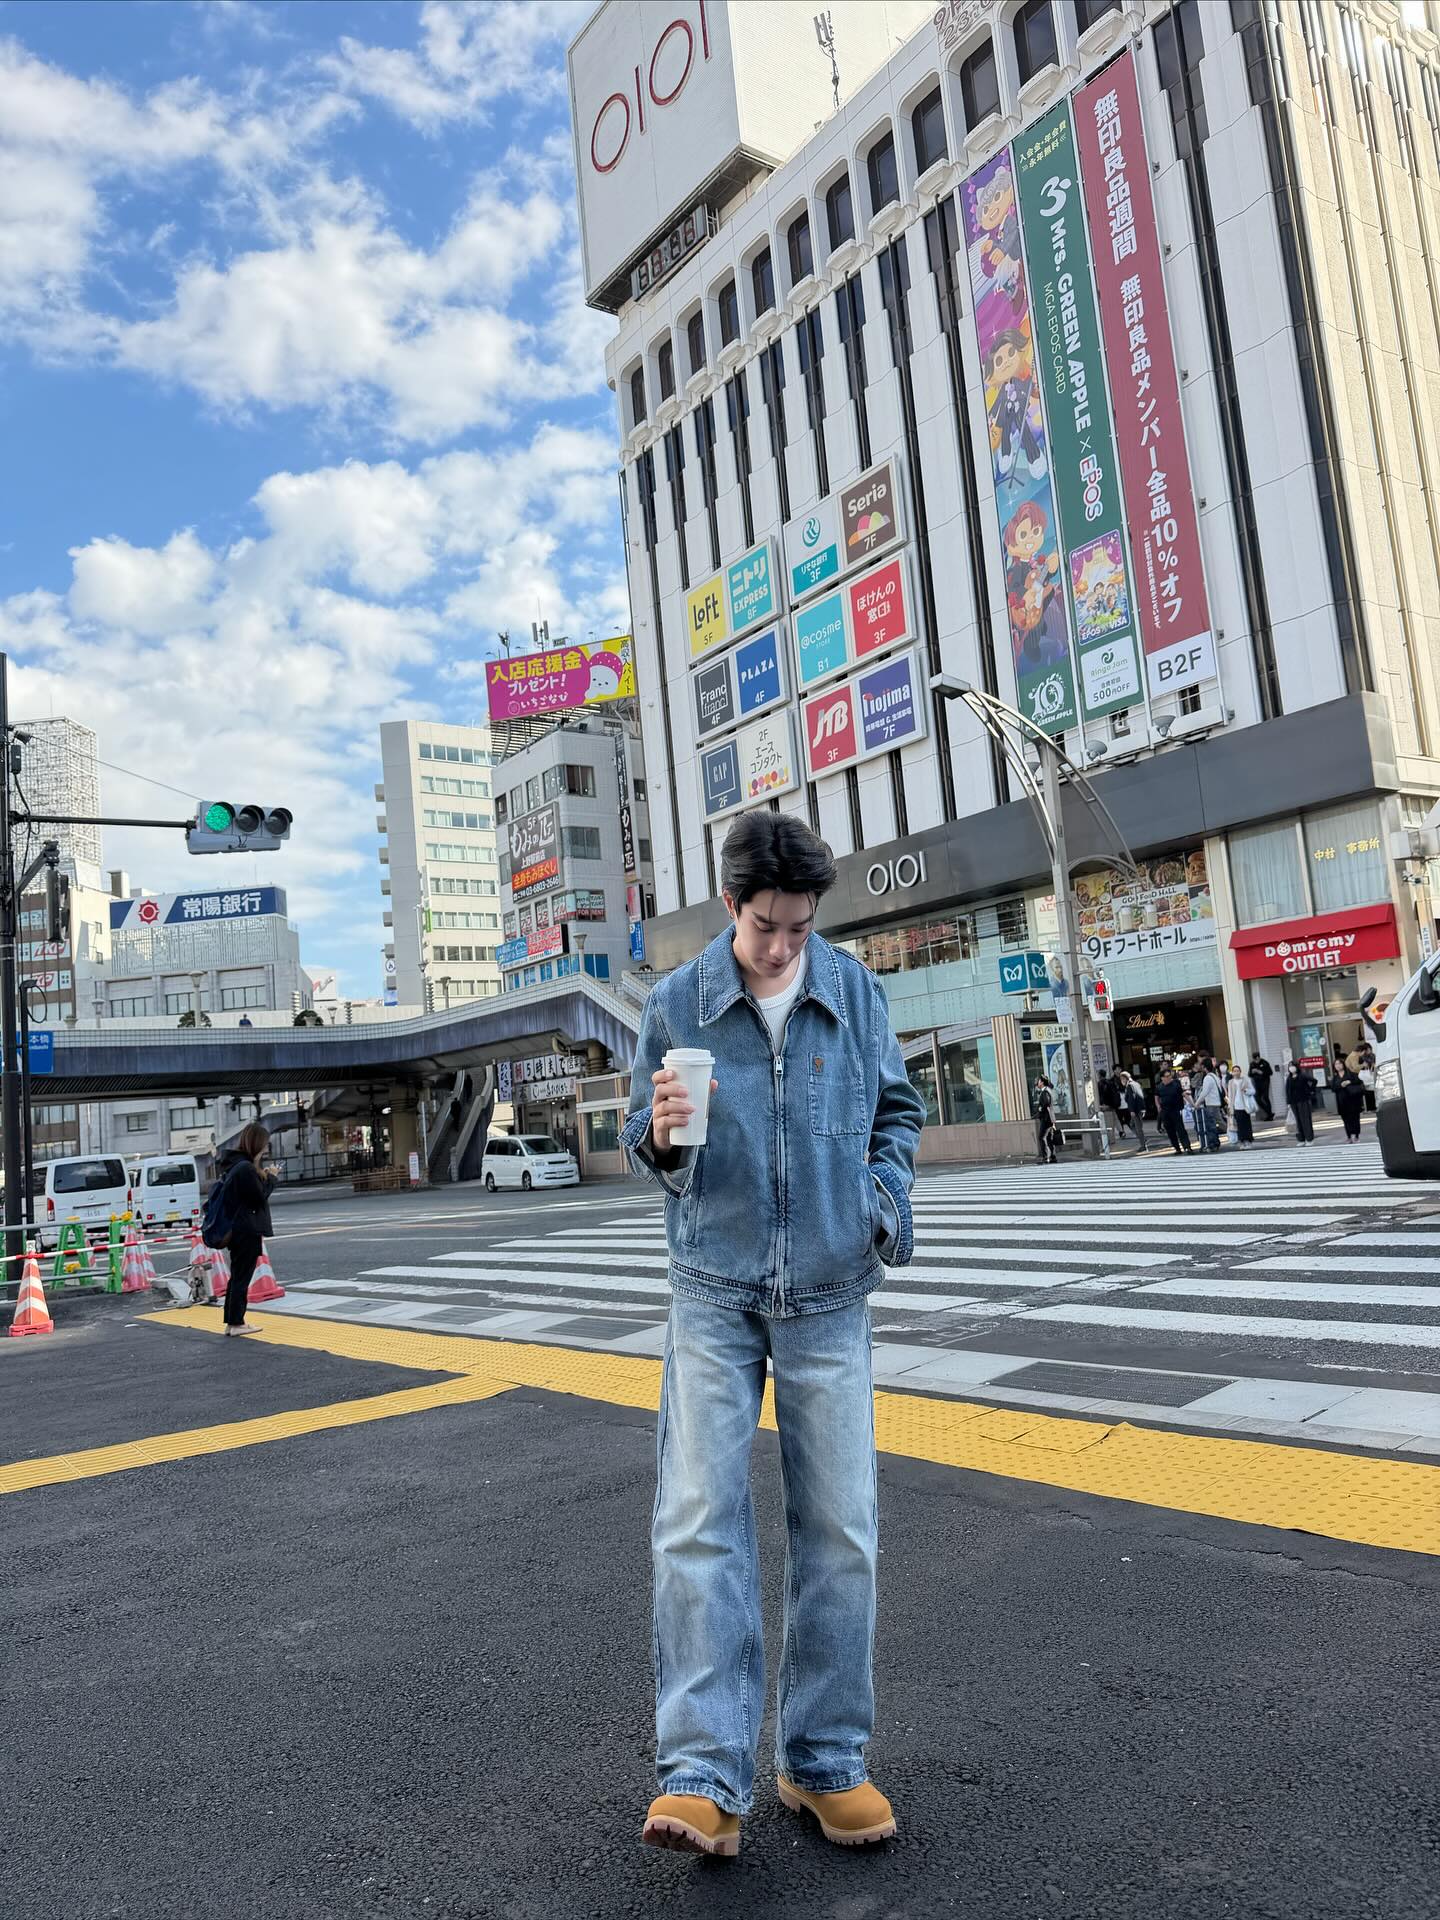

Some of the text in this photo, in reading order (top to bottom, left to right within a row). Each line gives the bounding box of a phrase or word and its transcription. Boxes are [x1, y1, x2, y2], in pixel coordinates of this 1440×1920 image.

[1093, 88, 1138, 265] 無印良品週間
[1050, 217, 1068, 273] Mrs.
[1057, 273, 1081, 355] GREEN
[1044, 281, 1066, 394] MGA EPOS CARD
[1067, 360, 1092, 433] APPLE
[847, 482, 888, 518] Seria
[864, 534, 877, 551] 7F
[732, 556, 767, 598] ニトリ
[810, 567, 821, 583] 3F
[734, 584, 769, 614] EXPRESS
[856, 581, 896, 612] ほけんの
[867, 602, 886, 624] 窓口
[1111, 614, 1128, 630] VISA
[704, 632, 714, 646] 5F
[801, 620, 842, 650] @cosme
[874, 628, 886, 644] 3F
[491, 650, 582, 685] 入店応援金
[741, 657, 775, 684] PLAZA
[817, 657, 829, 673] B1
[1157, 647, 1203, 683] B2F
[701, 684, 727, 702] Franc
[755, 690, 765, 704] 4F
[863, 683, 911, 718] nojima
[702, 696, 727, 714] franc
[711, 712, 721, 726] 4F
[812, 700, 848, 749] JTB
[758, 728, 768, 742] 2F
[882, 724, 896, 740] 7F
[755, 741, 775, 759] エース
[827, 748, 839, 762] 3F
[713, 761, 728, 783] GAP
[750, 752, 783, 775] コンタクト
[718, 795, 728, 808] 2F
[527, 816, 537, 831] 5F
[1314, 836, 1381, 862] 中村 事務所
[181, 892, 262, 919] 常陽銀行
[1282, 950, 1341, 973] OUTLET
